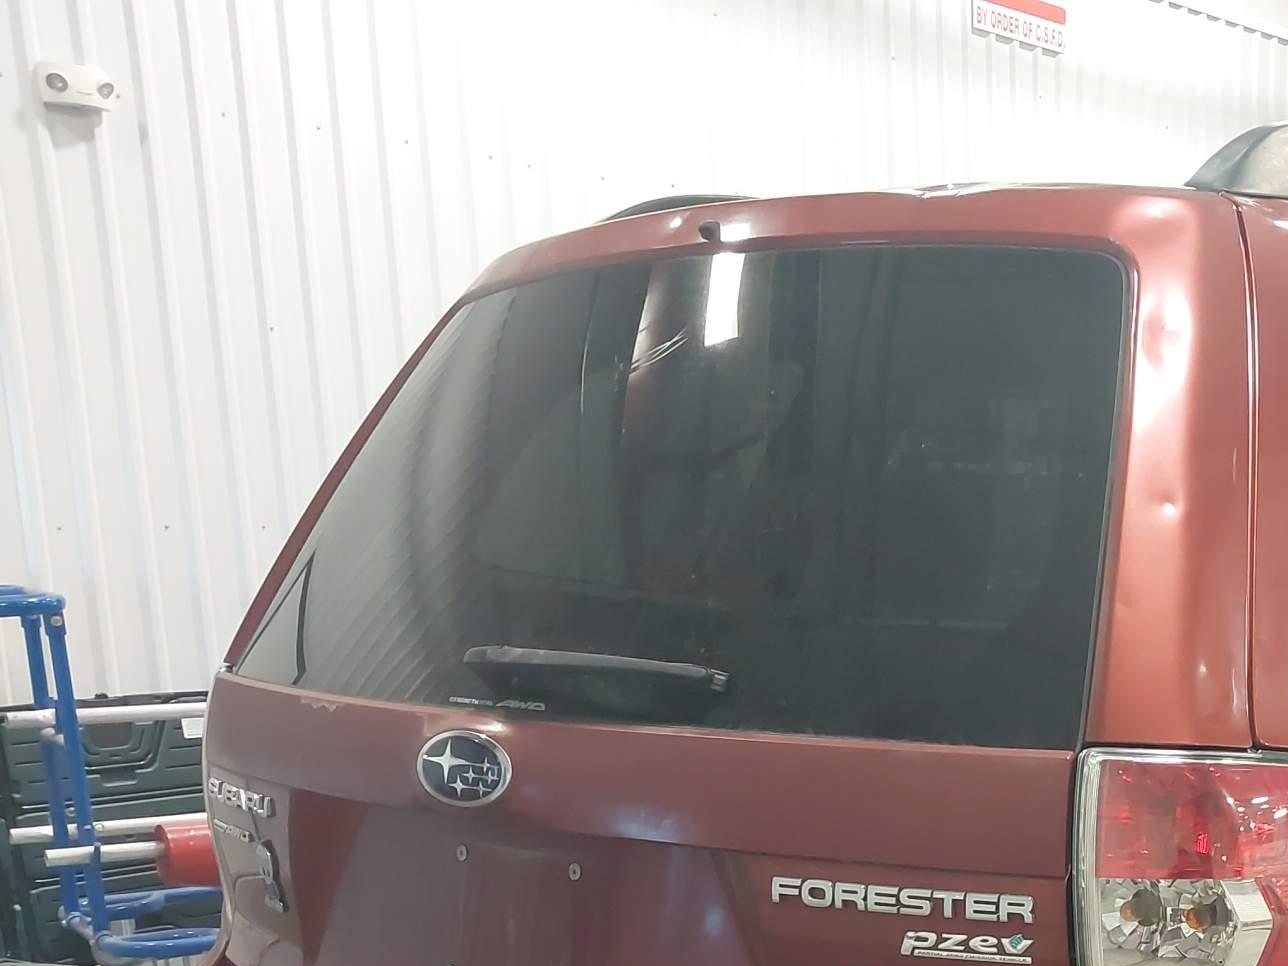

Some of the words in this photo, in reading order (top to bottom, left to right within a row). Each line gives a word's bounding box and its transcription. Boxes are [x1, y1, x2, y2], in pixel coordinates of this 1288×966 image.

[976, 6, 988, 25] BY
[991, 10, 1019, 36] ORDER
[1022, 20, 1033, 38] OF
[208, 777, 273, 818] SUBARU
[771, 876, 1034, 924] FORESTER
